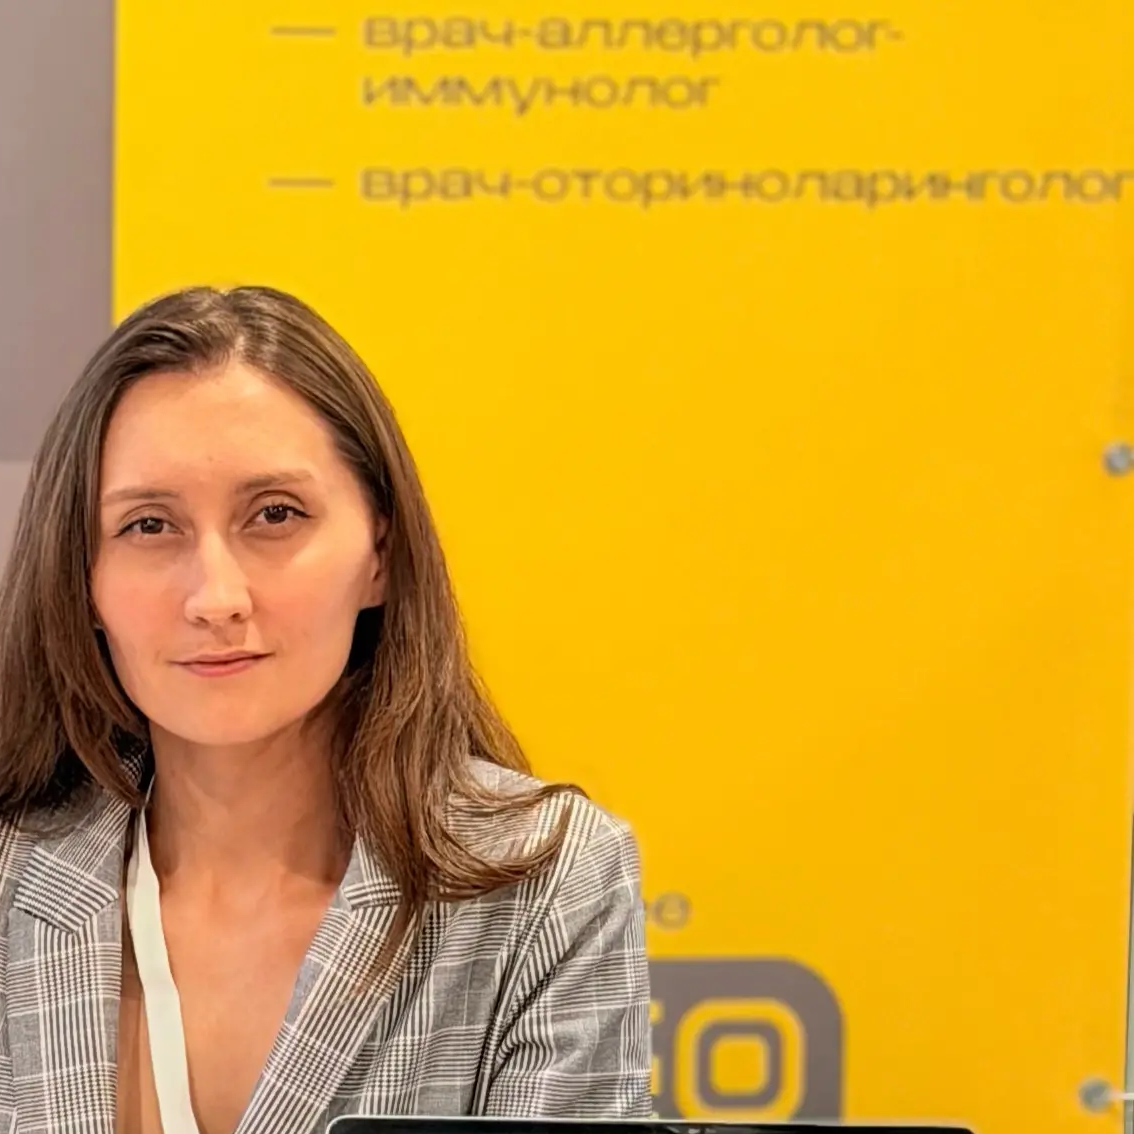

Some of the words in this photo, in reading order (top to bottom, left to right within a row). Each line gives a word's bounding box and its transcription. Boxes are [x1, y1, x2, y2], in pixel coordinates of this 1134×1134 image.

[362, 17, 904, 57] врач-аллерголог-
[362, 75, 721, 116] иммунолог
[361, 167, 1134, 209] врач-оториноларинголог
